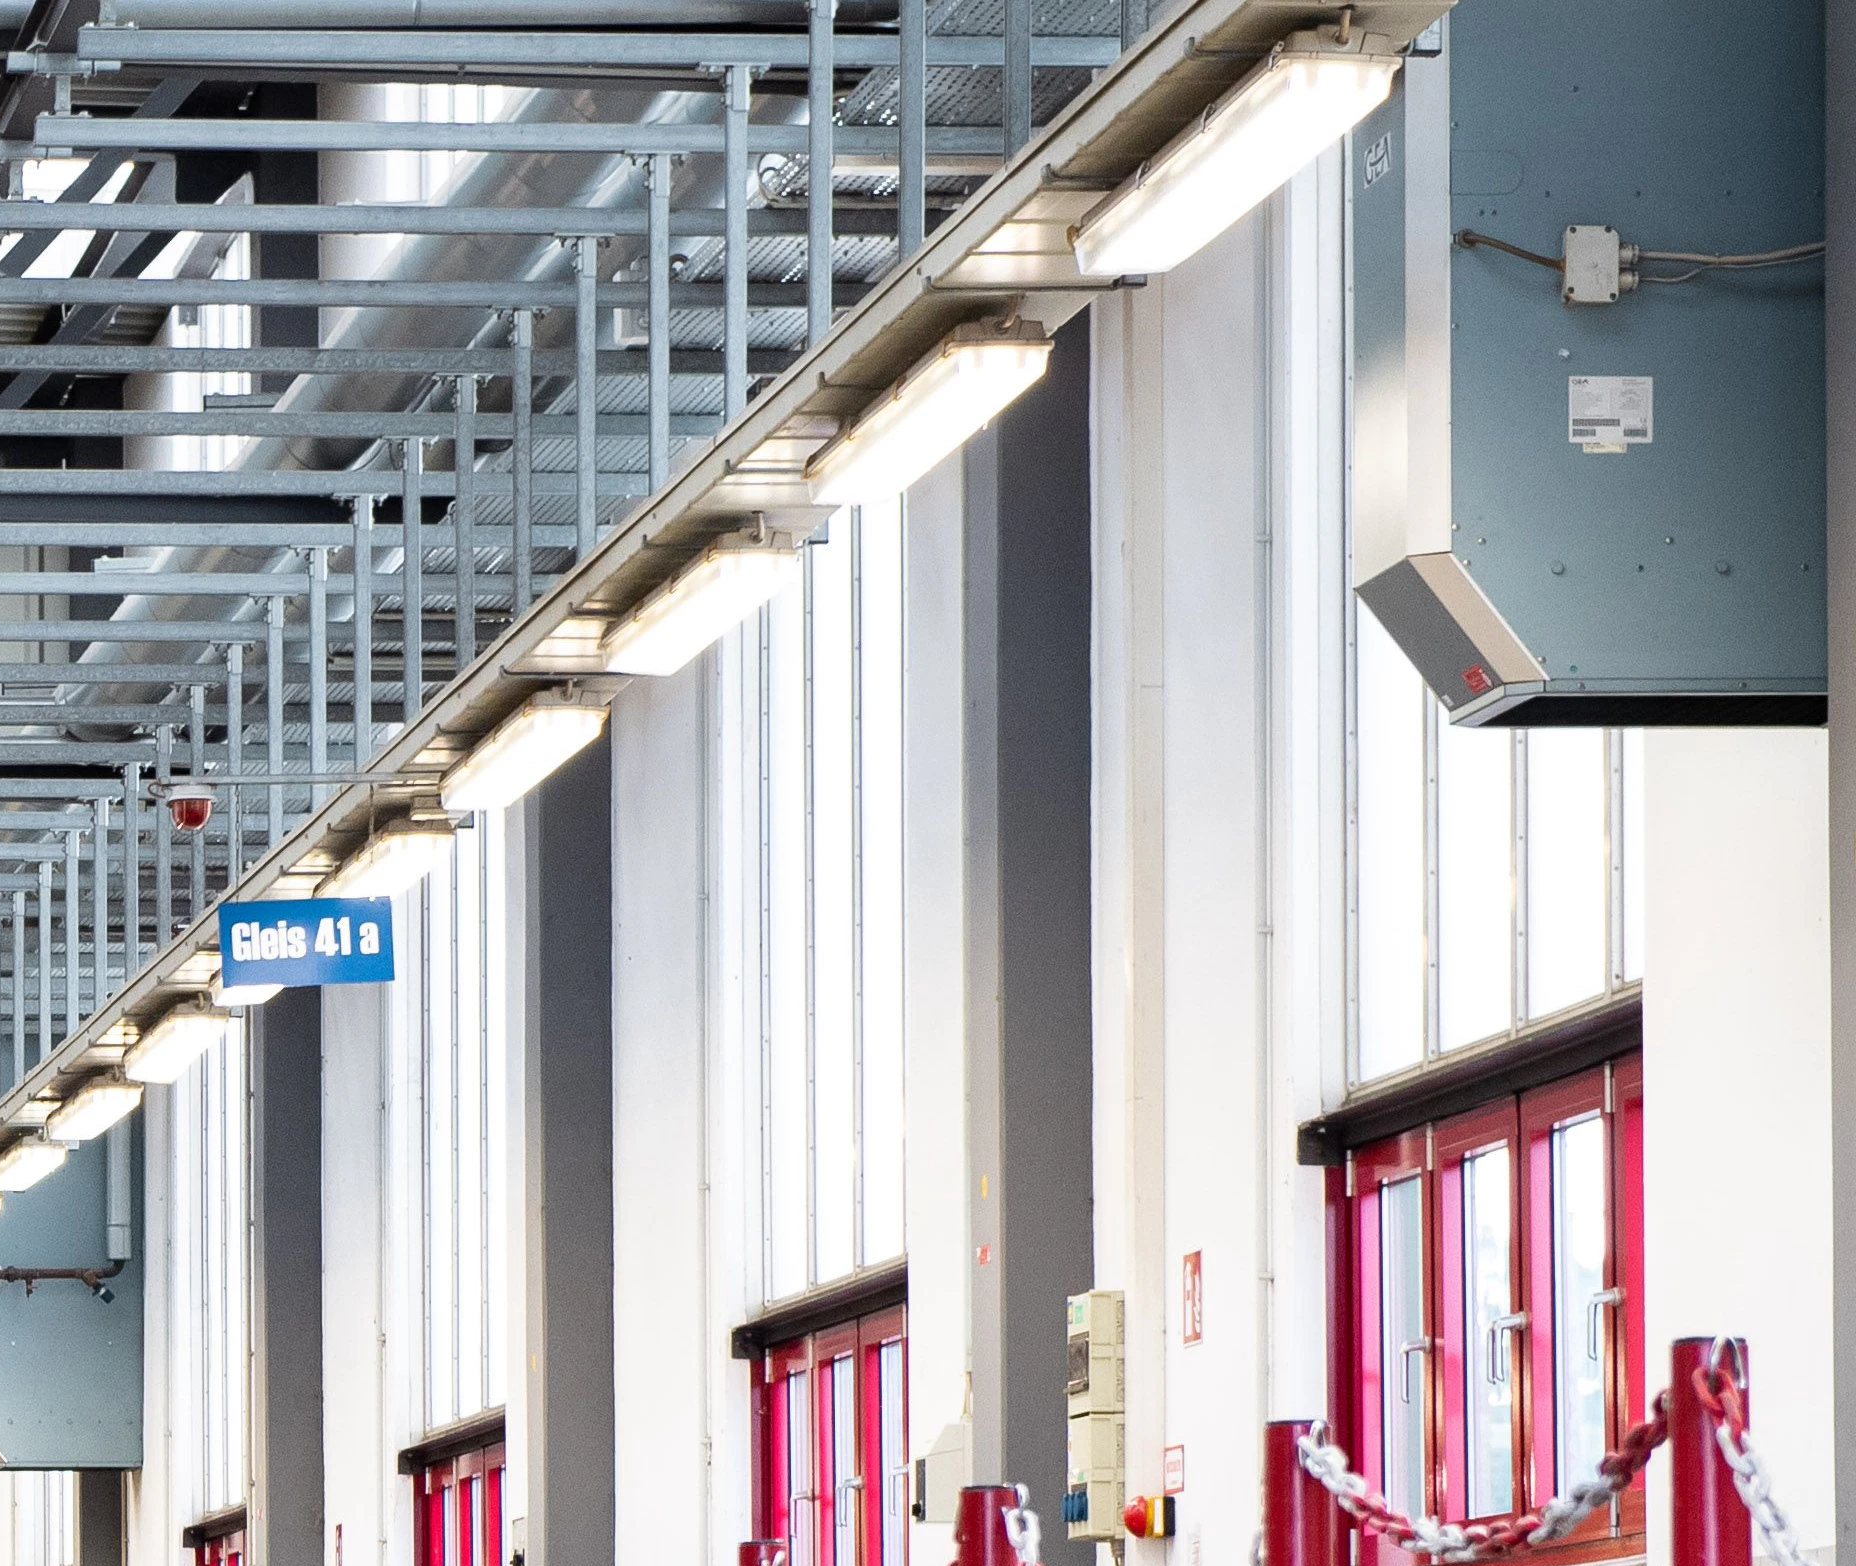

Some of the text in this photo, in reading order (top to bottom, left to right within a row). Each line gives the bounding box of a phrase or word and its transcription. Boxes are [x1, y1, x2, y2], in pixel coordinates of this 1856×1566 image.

[230, 917, 380, 962] Gleis 41 a
